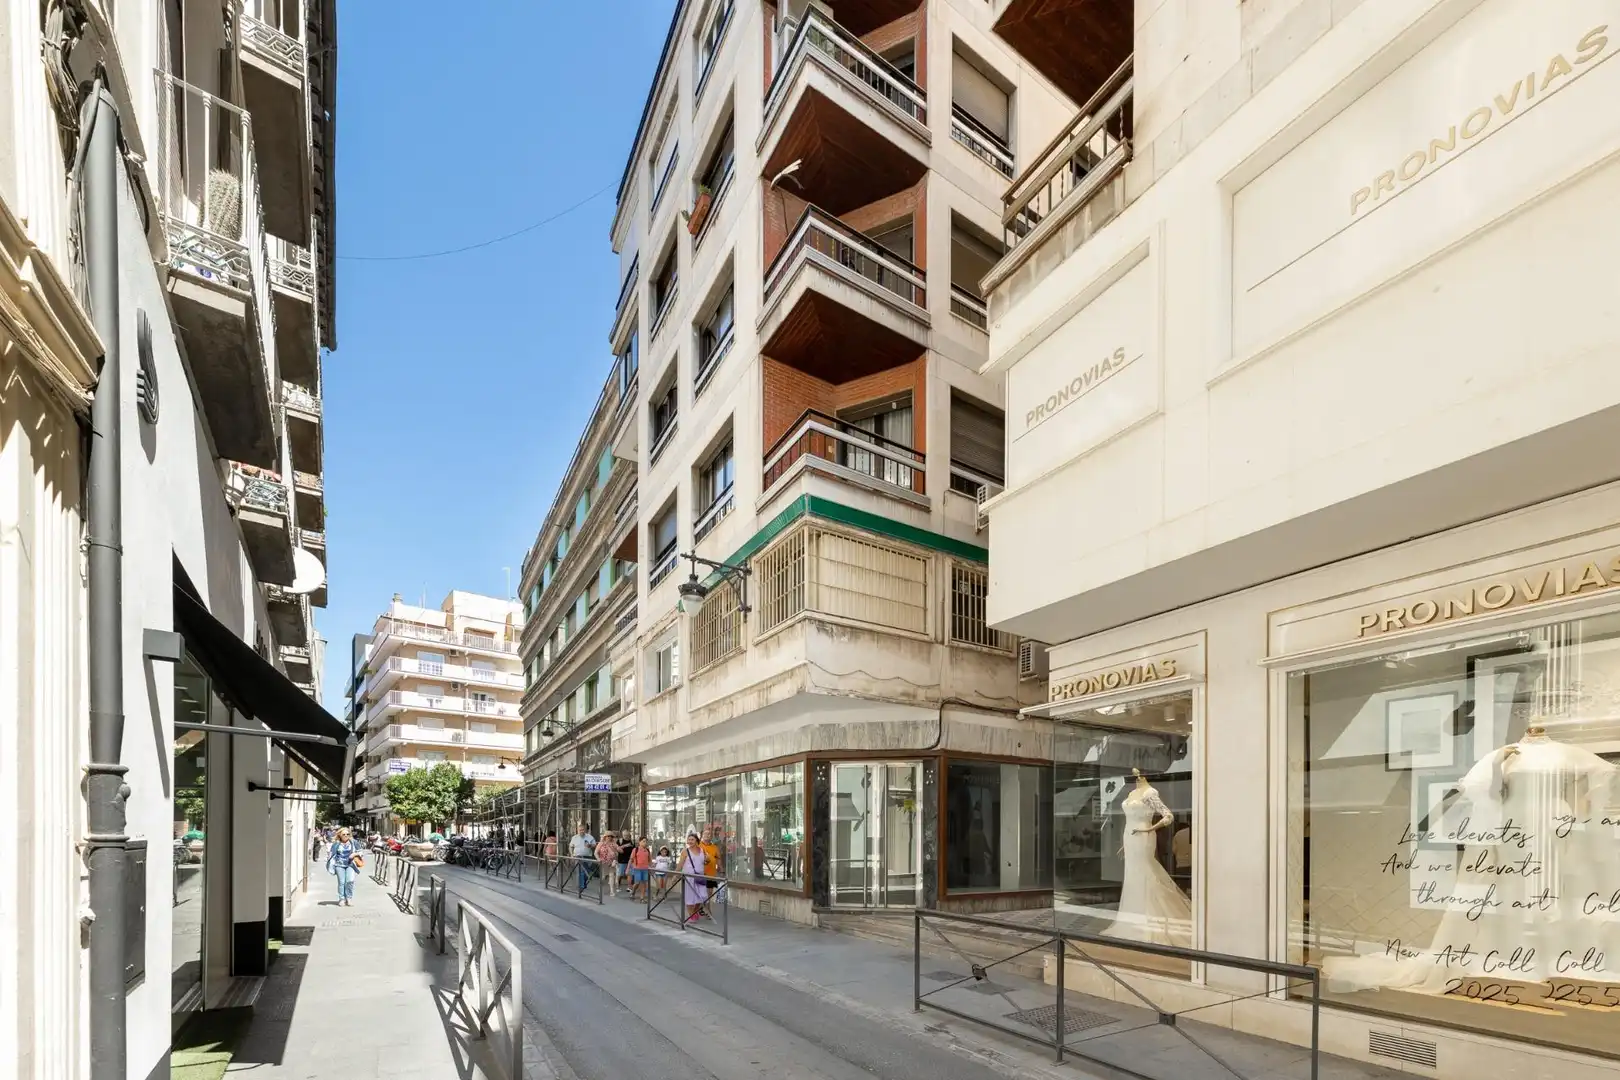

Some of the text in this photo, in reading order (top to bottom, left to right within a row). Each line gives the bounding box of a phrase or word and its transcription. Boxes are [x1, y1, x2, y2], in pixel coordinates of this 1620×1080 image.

[1350, 24, 1608, 216] PRONOVIAS
[1025, 346, 1126, 429] PRONOVIAS
[1051, 659, 1177, 701] PRONOVIAS
[1397, 817, 1534, 848] Love elevates
[1381, 849, 1543, 878] And we elevate
[1412, 880, 1559, 922] through art
[1386, 939, 1607, 973] New Art Coll Coll
[1444, 978, 1526, 1006] 2025
